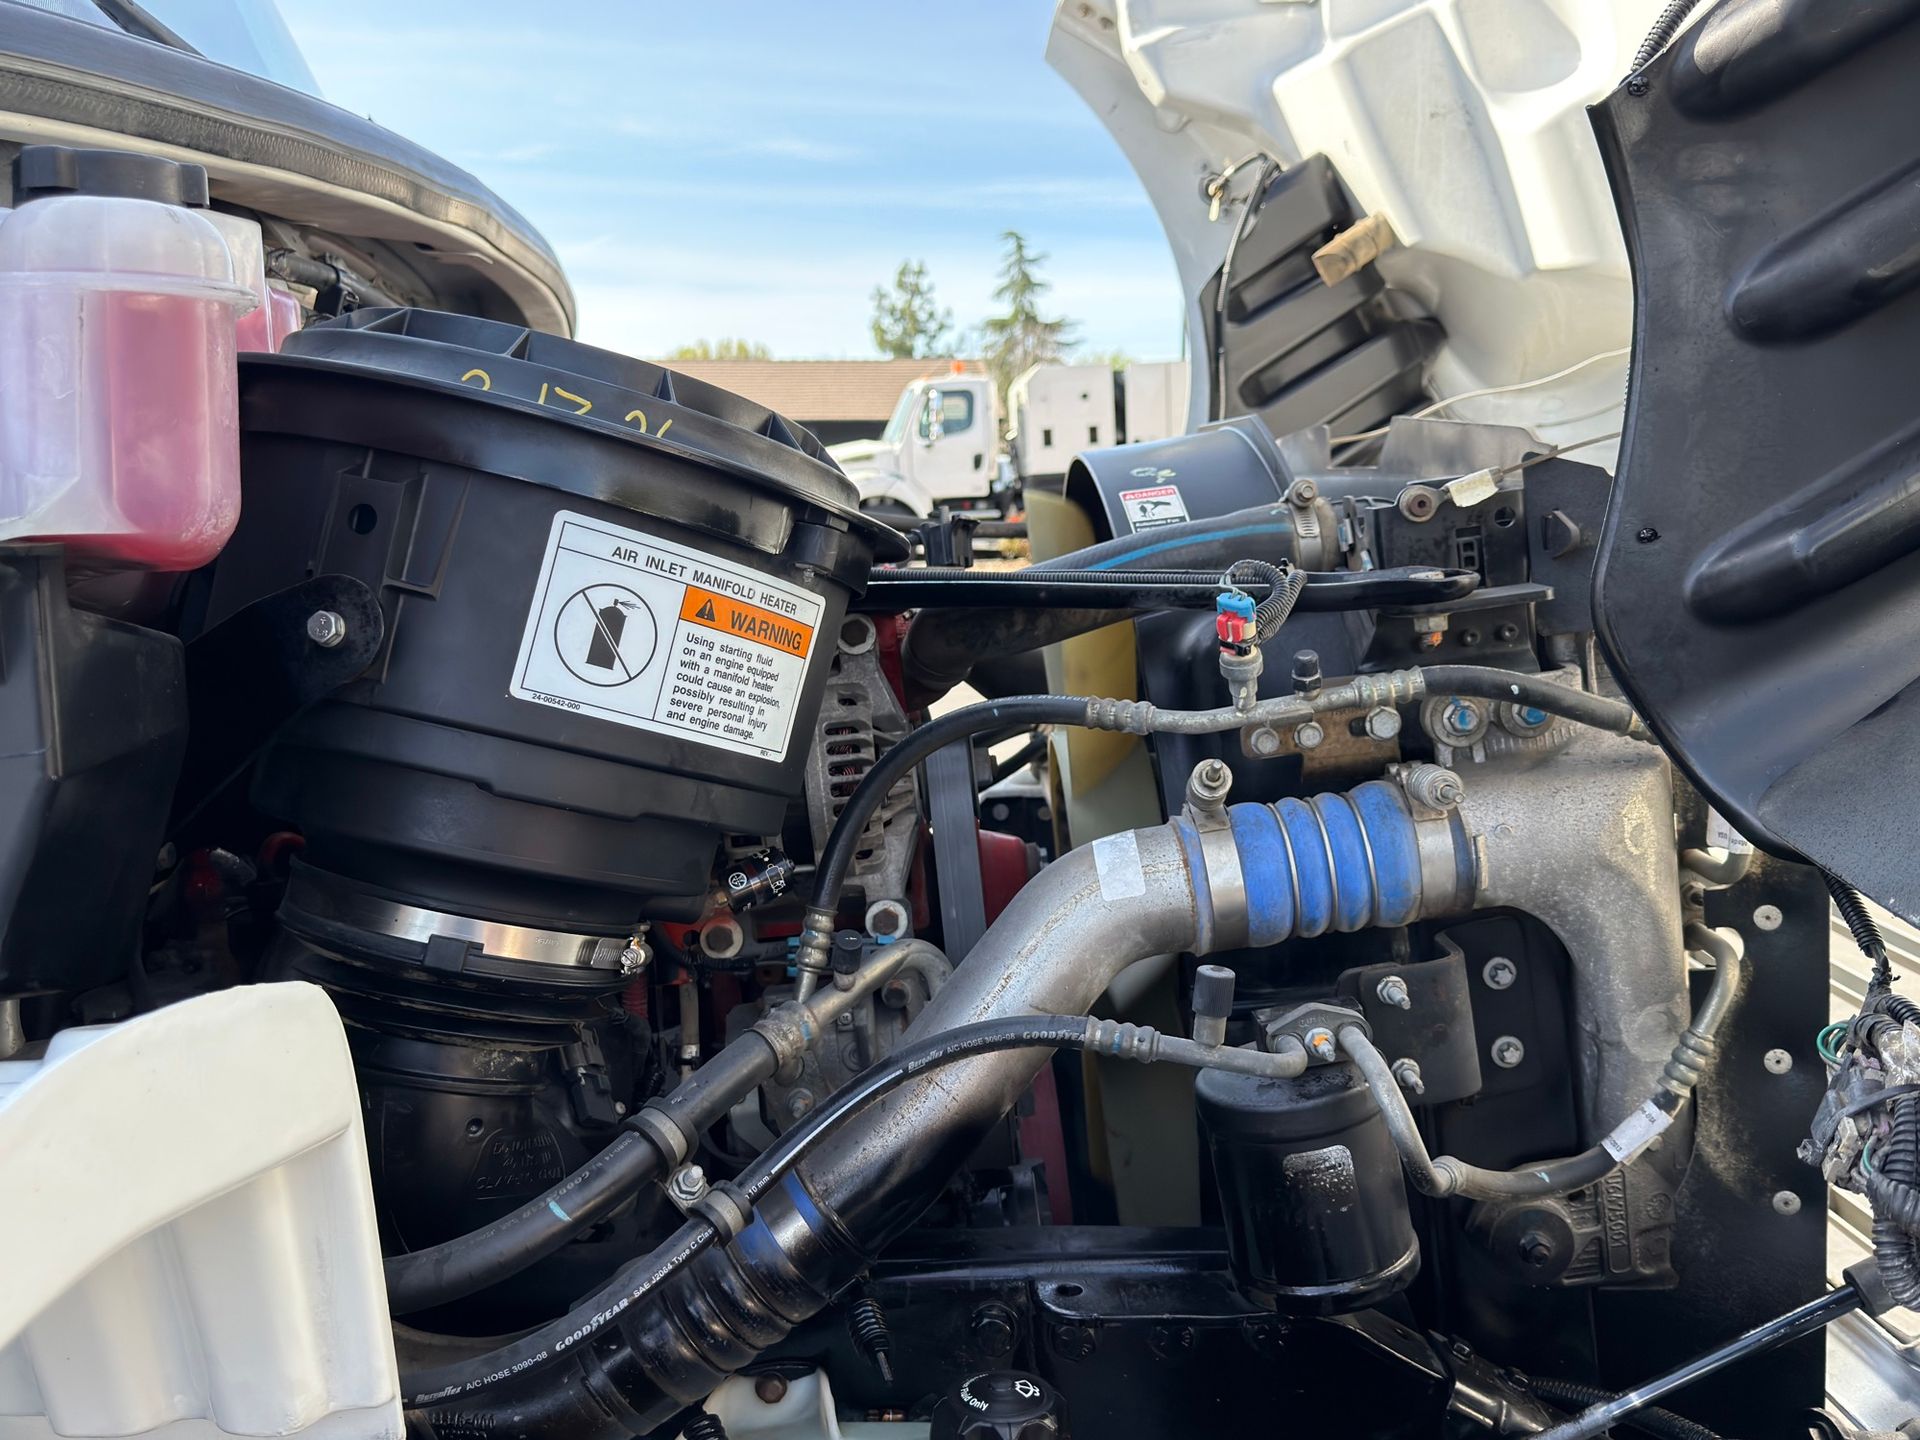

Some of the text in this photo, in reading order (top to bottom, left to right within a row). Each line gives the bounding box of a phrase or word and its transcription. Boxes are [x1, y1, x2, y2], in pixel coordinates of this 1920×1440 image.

[1134, 488, 1174, 498] DANGER
[611, 545, 797, 615] AIR INLET MANIFOLD HEATER
[730, 610, 802, 651] WARNING
[682, 647, 779, 682] on an engine equipped
[686, 632, 773, 667] Using starting fluid
[676, 672, 704, 686] could
[706, 680, 733, 694] cause
[735, 688, 746, 698] an
[680, 659, 774, 693] with a manifold heater
[532, 693, 580, 710] 24-00542-000
[669, 697, 768, 732] severe personal injury
[672, 684, 765, 716] possibly resulting in
[666, 710, 754, 740] and engine damage.
[946, 1044, 960, 1055] A/C
[961, 1037, 984, 1050] HOSE
[984, 1032, 1016, 1045] 3090-08
[1022, 1029, 1086, 1042] GOODYEA
[748, 1175, 770, 1196] 10 mm
[466, 1379, 482, 1391] A/C
[484, 1368, 511, 1385] HOSE
[512, 1351, 548, 1374] 3090-08
[555, 1297, 630, 1352] GOODYEAR
[633, 1281, 651, 1298] SAE
[672, 1247, 691, 1264] Type
[690, 1241, 697, 1250] C
[969, 1398, 989, 1410] Only
